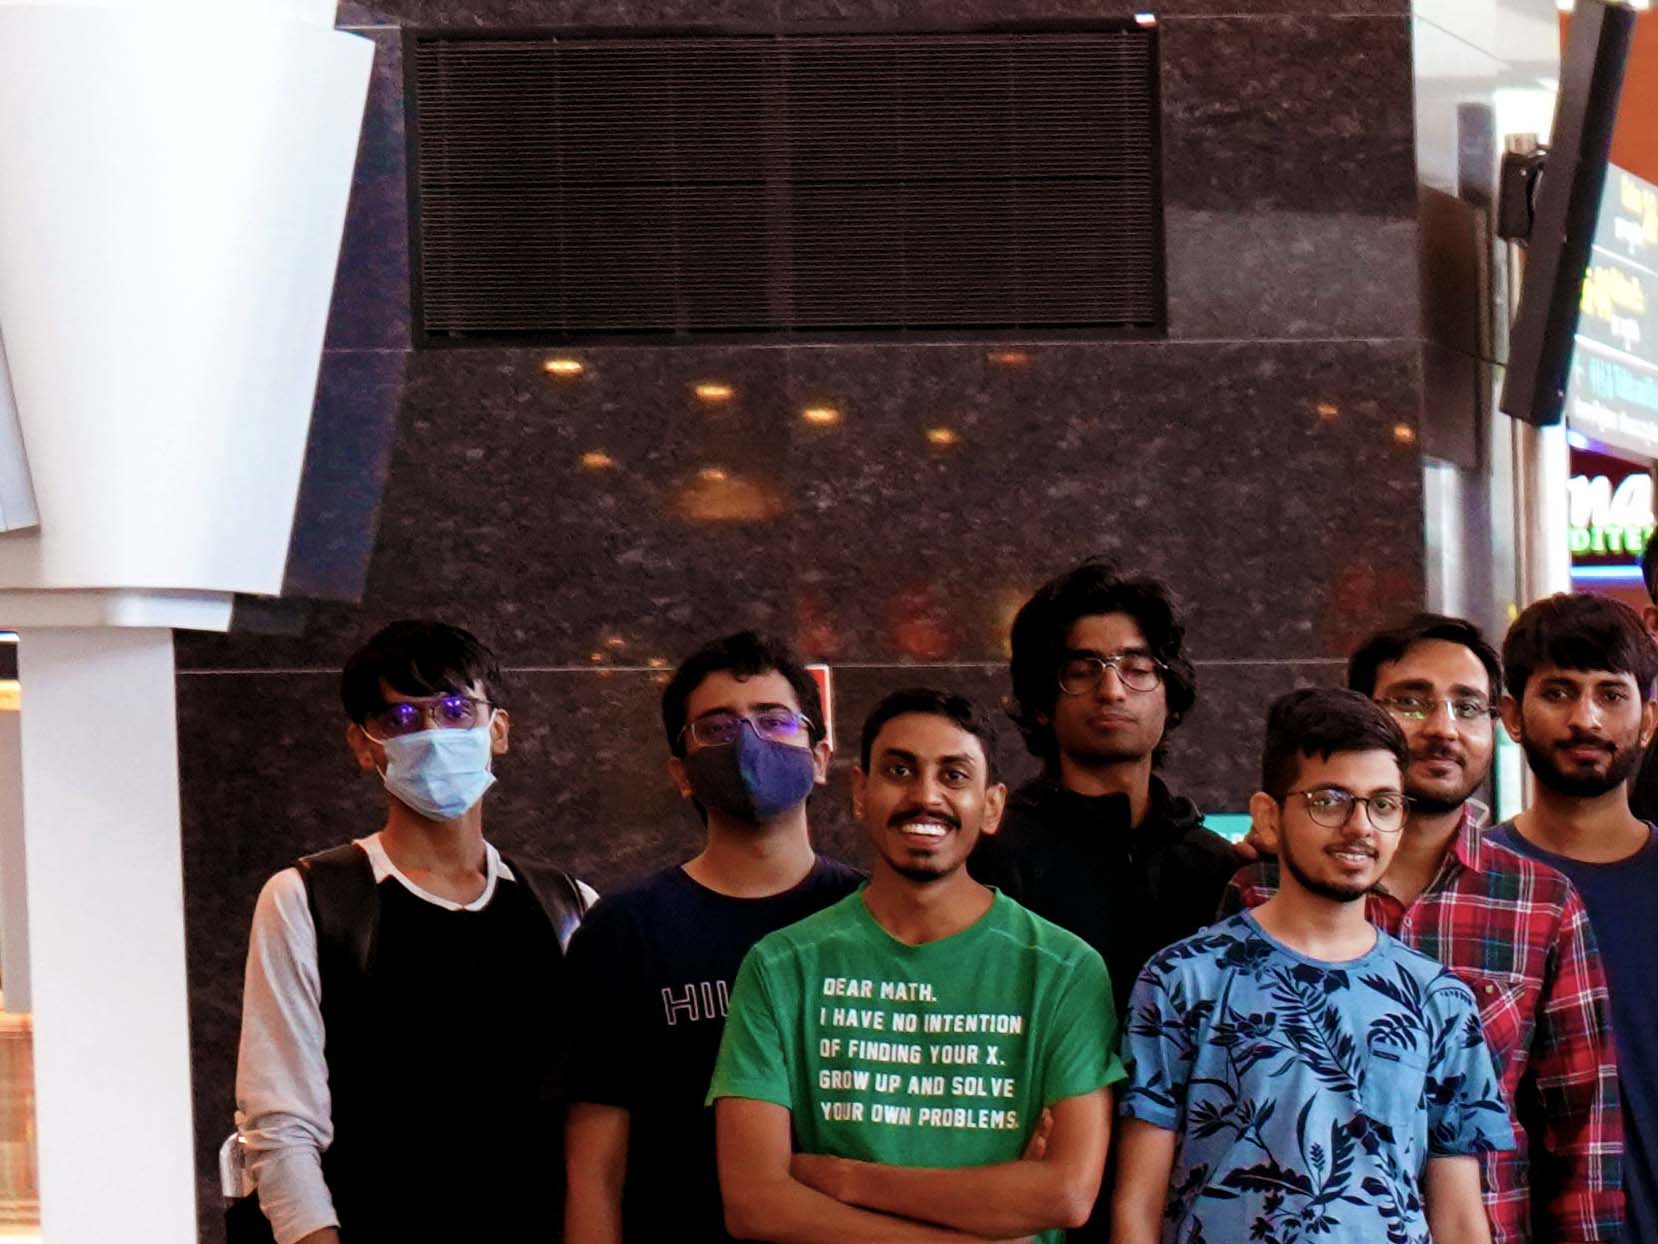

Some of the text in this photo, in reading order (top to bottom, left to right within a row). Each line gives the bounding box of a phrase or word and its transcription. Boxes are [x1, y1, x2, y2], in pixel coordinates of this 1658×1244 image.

[823, 978, 937, 1001] DEAR MATH.
[820, 1007, 1022, 1034] I HAVE NO INTENTION
[820, 1039, 1005, 1065] OF FINDING YOUR X.
[819, 1070, 1015, 1097] GROW UP AND SOLVE
[820, 1102, 1019, 1129] YOUR OWN PROBLEMS.
